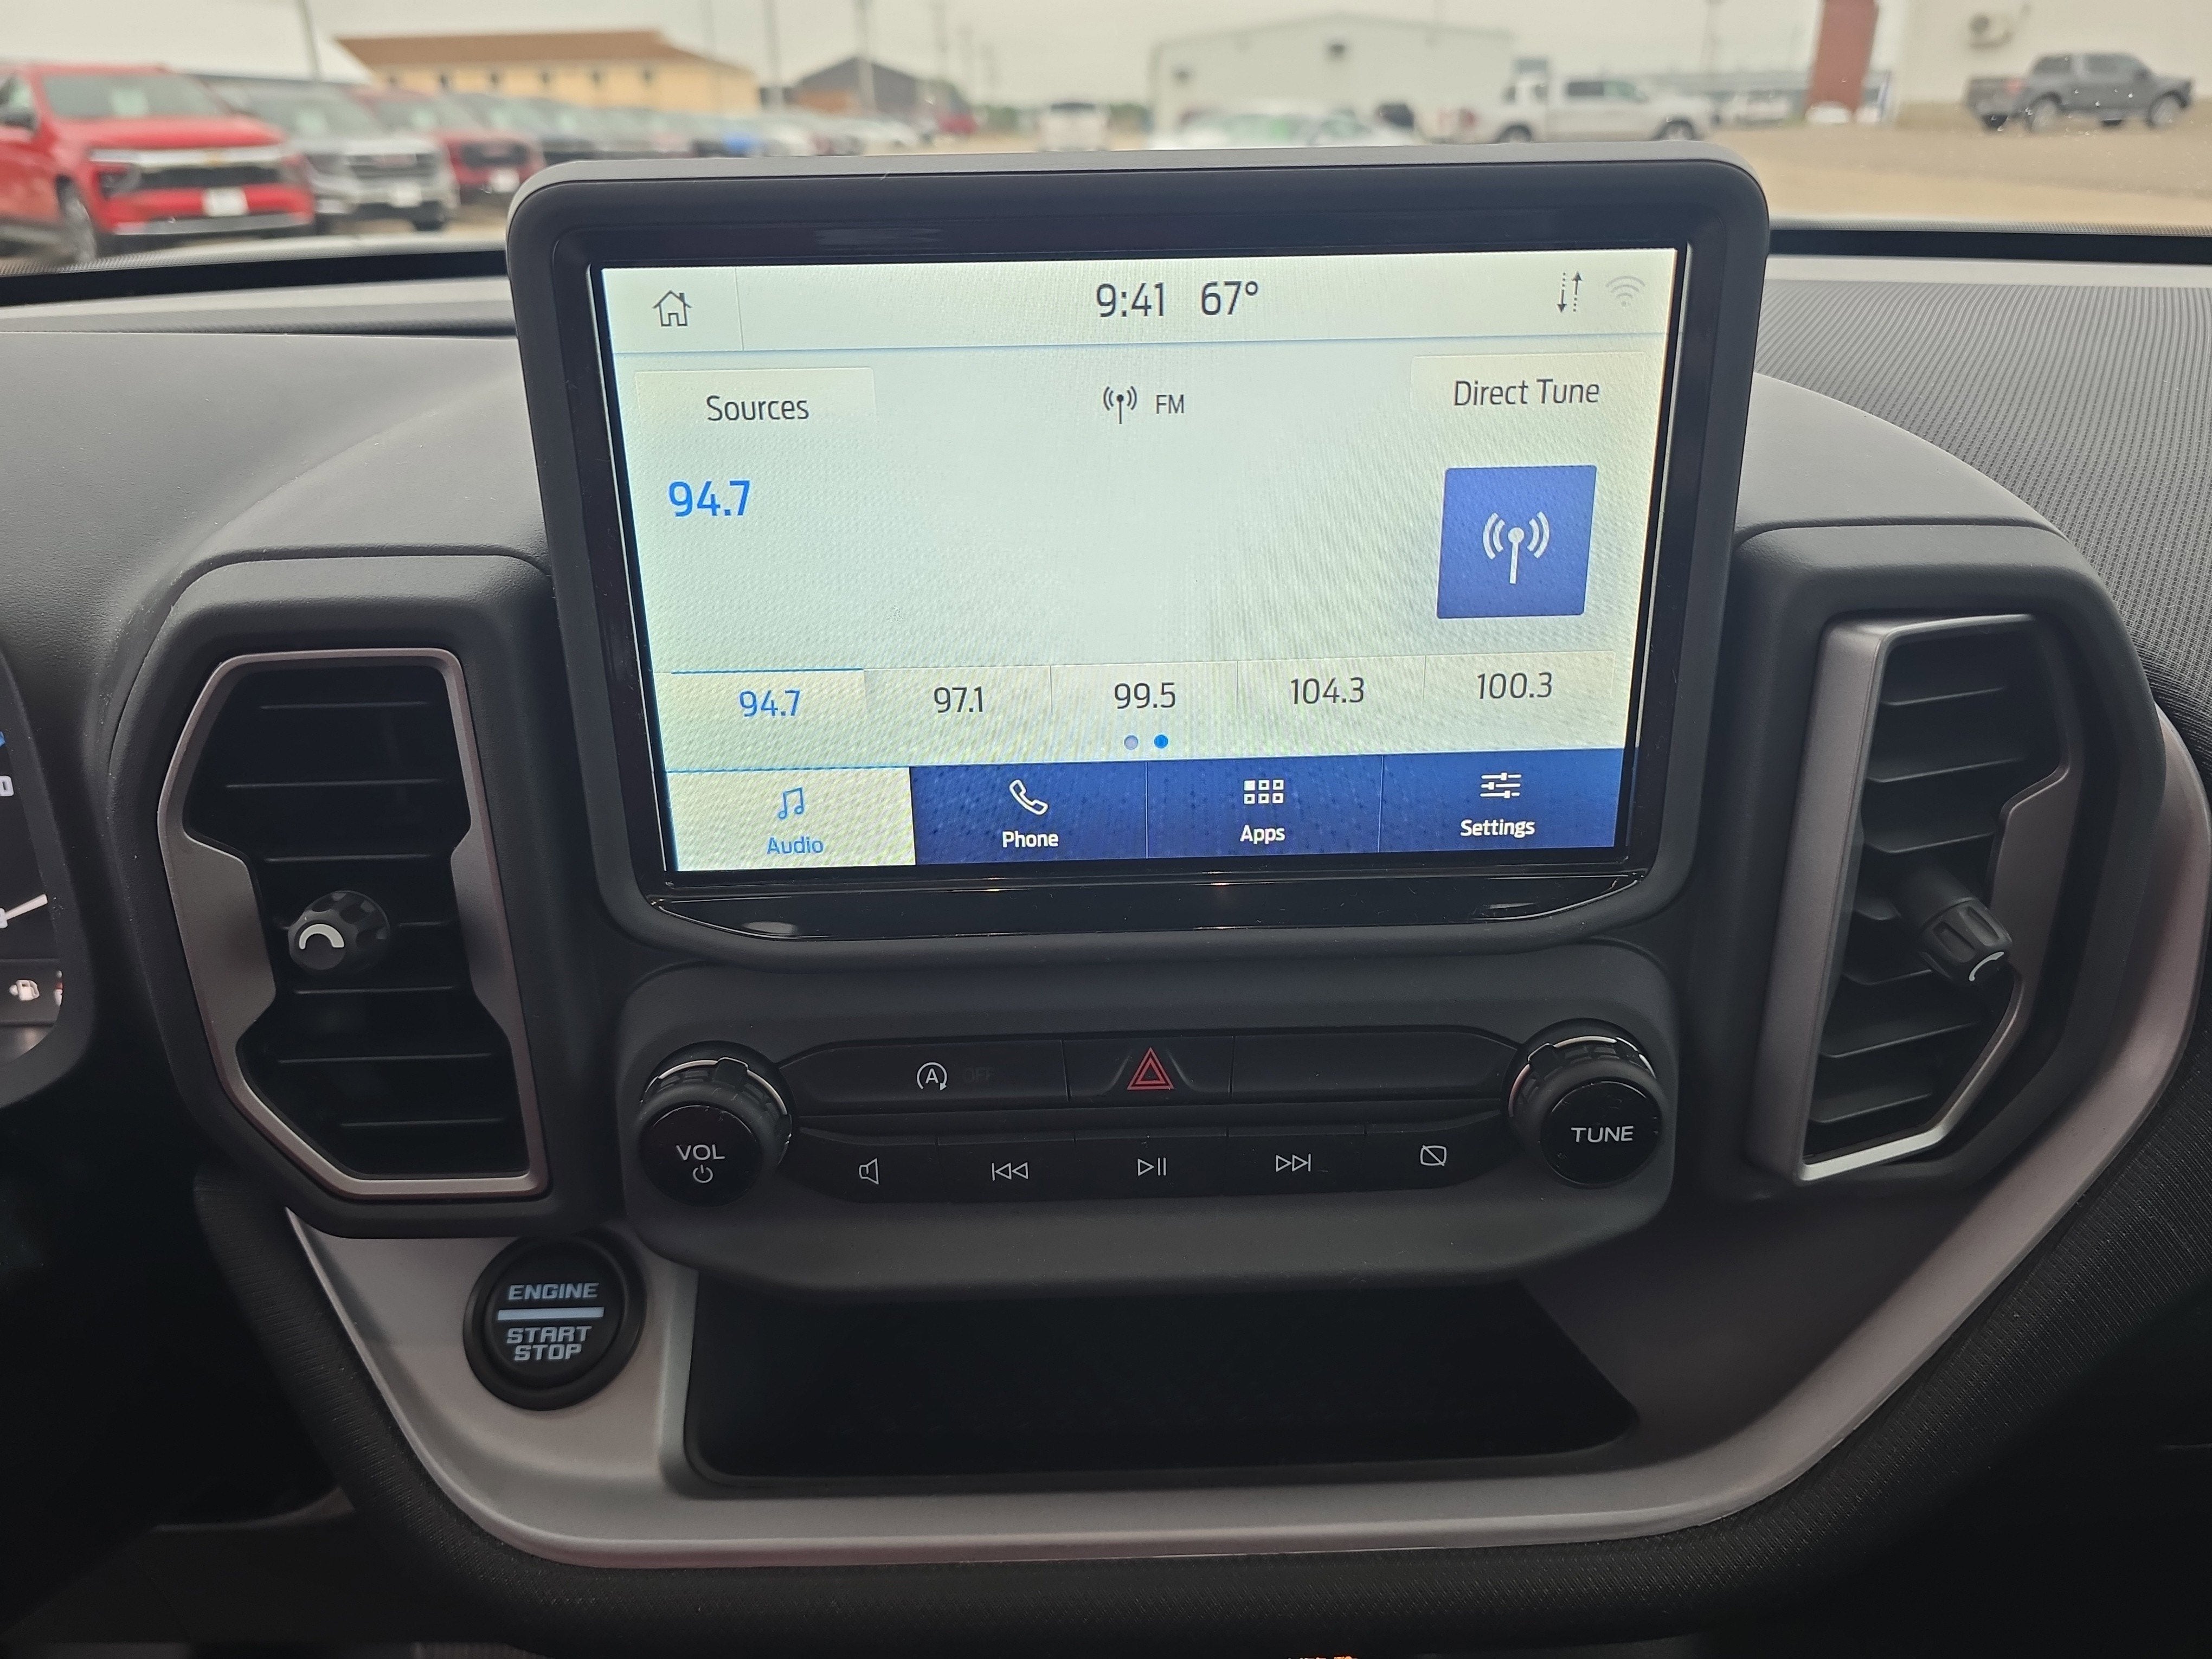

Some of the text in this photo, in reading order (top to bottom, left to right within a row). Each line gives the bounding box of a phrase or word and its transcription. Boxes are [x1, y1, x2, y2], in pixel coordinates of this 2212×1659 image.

[1096, 280, 1259, 318] 9:41 67°
[1454, 378, 1600, 406] Direct Tune
[706, 395, 809, 421] Sources
[1156, 394, 1185, 415] FM
[668, 479, 751, 517] 94.7
[1114, 681, 1176, 710] 99.5
[1290, 677, 1365, 705] 104.3
[1477, 672, 1552, 699] 100.3
[739, 689, 801, 717] 94.7
[934, 686, 983, 713] 97.1
[1002, 829, 1059, 848] Phone
[1239, 824, 1285, 845] Apps
[1459, 817, 1535, 839] Settings
[767, 835, 824, 855] Audio
[1571, 1126, 1634, 1143] TUNE
[676, 1144, 725, 1161] VOL
[508, 1282, 599, 1300] ENGINE
[506, 1326, 593, 1343] START
[515, 1343, 582, 1361] STOP
